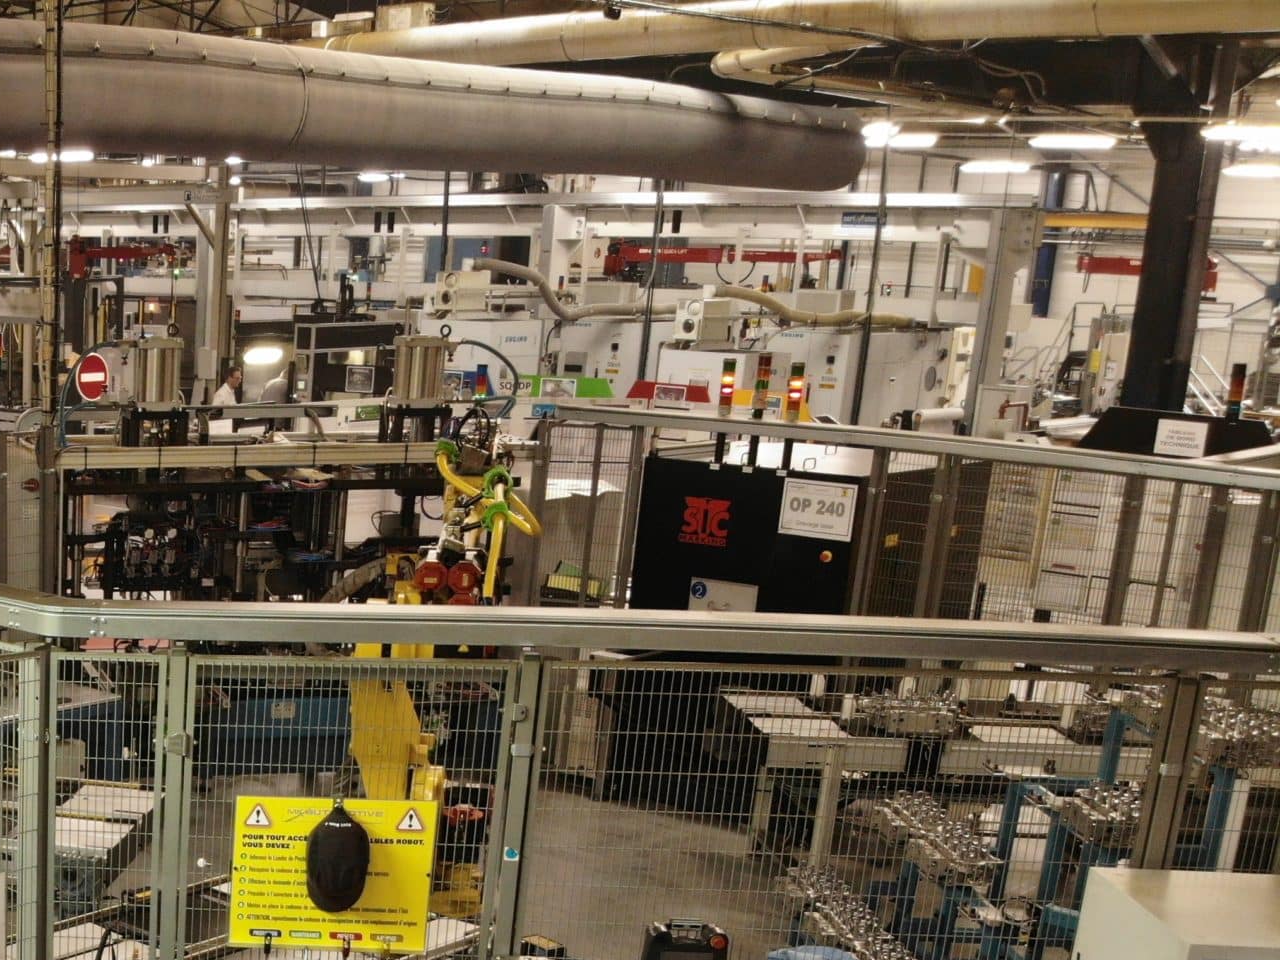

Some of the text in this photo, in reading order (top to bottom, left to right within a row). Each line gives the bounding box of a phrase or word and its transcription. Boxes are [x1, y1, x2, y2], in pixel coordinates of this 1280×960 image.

[499, 381, 532, 391] SQDP
[789, 497, 846, 518] OP 240
[695, 585, 704, 599] 2
